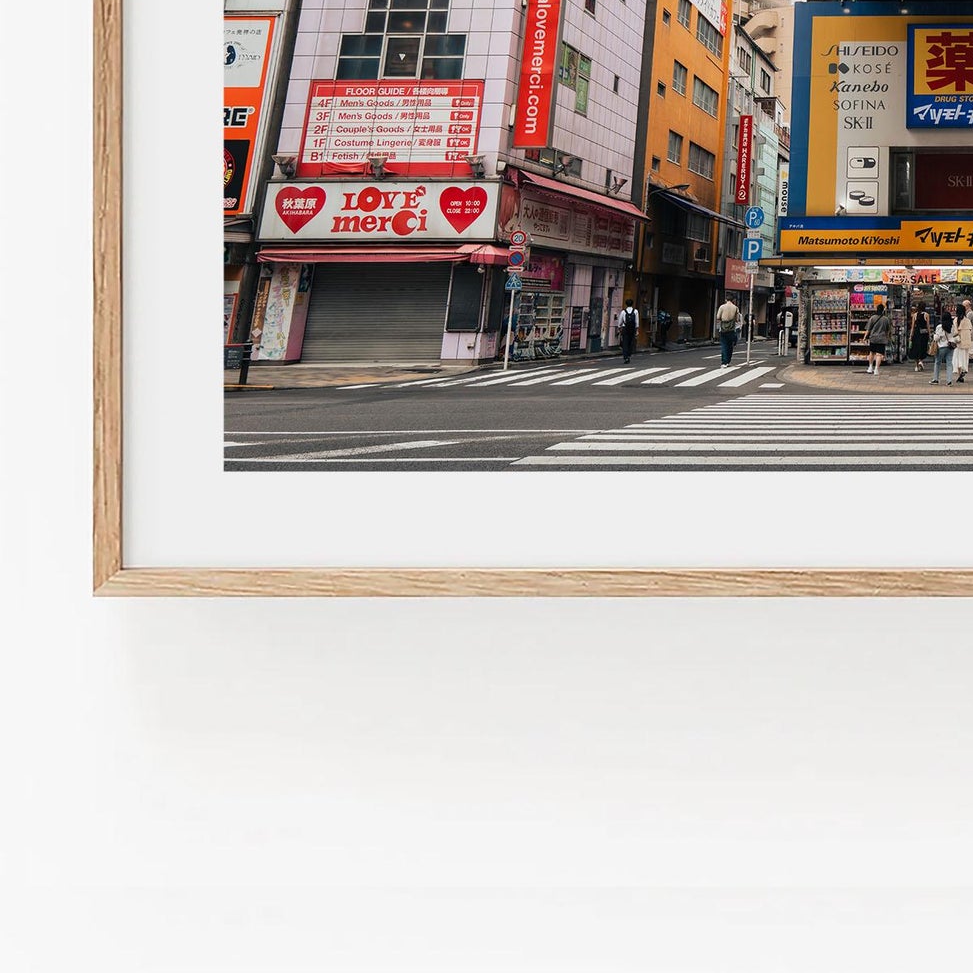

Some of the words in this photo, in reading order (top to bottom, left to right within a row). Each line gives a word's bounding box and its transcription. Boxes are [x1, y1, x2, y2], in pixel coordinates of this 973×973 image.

[821, 44, 899, 56] SHISEIDO
[853, 62, 892, 74] KOSÉ
[829, 80, 889, 93] Kanebo
[345, 88, 376, 96] FLOOR
[378, 88, 405, 96] GUIDE
[318, 99, 333, 108] 4F
[934, 95, 957, 103] DRUG
[833, 100, 886, 111] SOFINA
[316, 112, 331, 121] 3F
[338, 112, 362, 120] Men's
[364, 112, 393, 120] Goods
[313, 125, 329, 134] 2F
[336, 125, 374, 134] Couple's
[376, 125, 405, 133] Goods
[313, 138, 327, 148] 1F
[334, 138, 375, 147] Costume
[376, 138, 412, 148] Lingerie
[310, 151, 324, 161] B1
[332, 152, 359, 160] Fetish
[282, 197, 317, 209] 秋葉原
[341, 187, 422, 213] LOVE
[514, 234, 523, 242] 20
[798, 236, 860, 245] Matsumoto
[861, 235, 900, 245] KiYoshi
[747, 240, 760, 260] P
[911, 274, 937, 284] SALE
